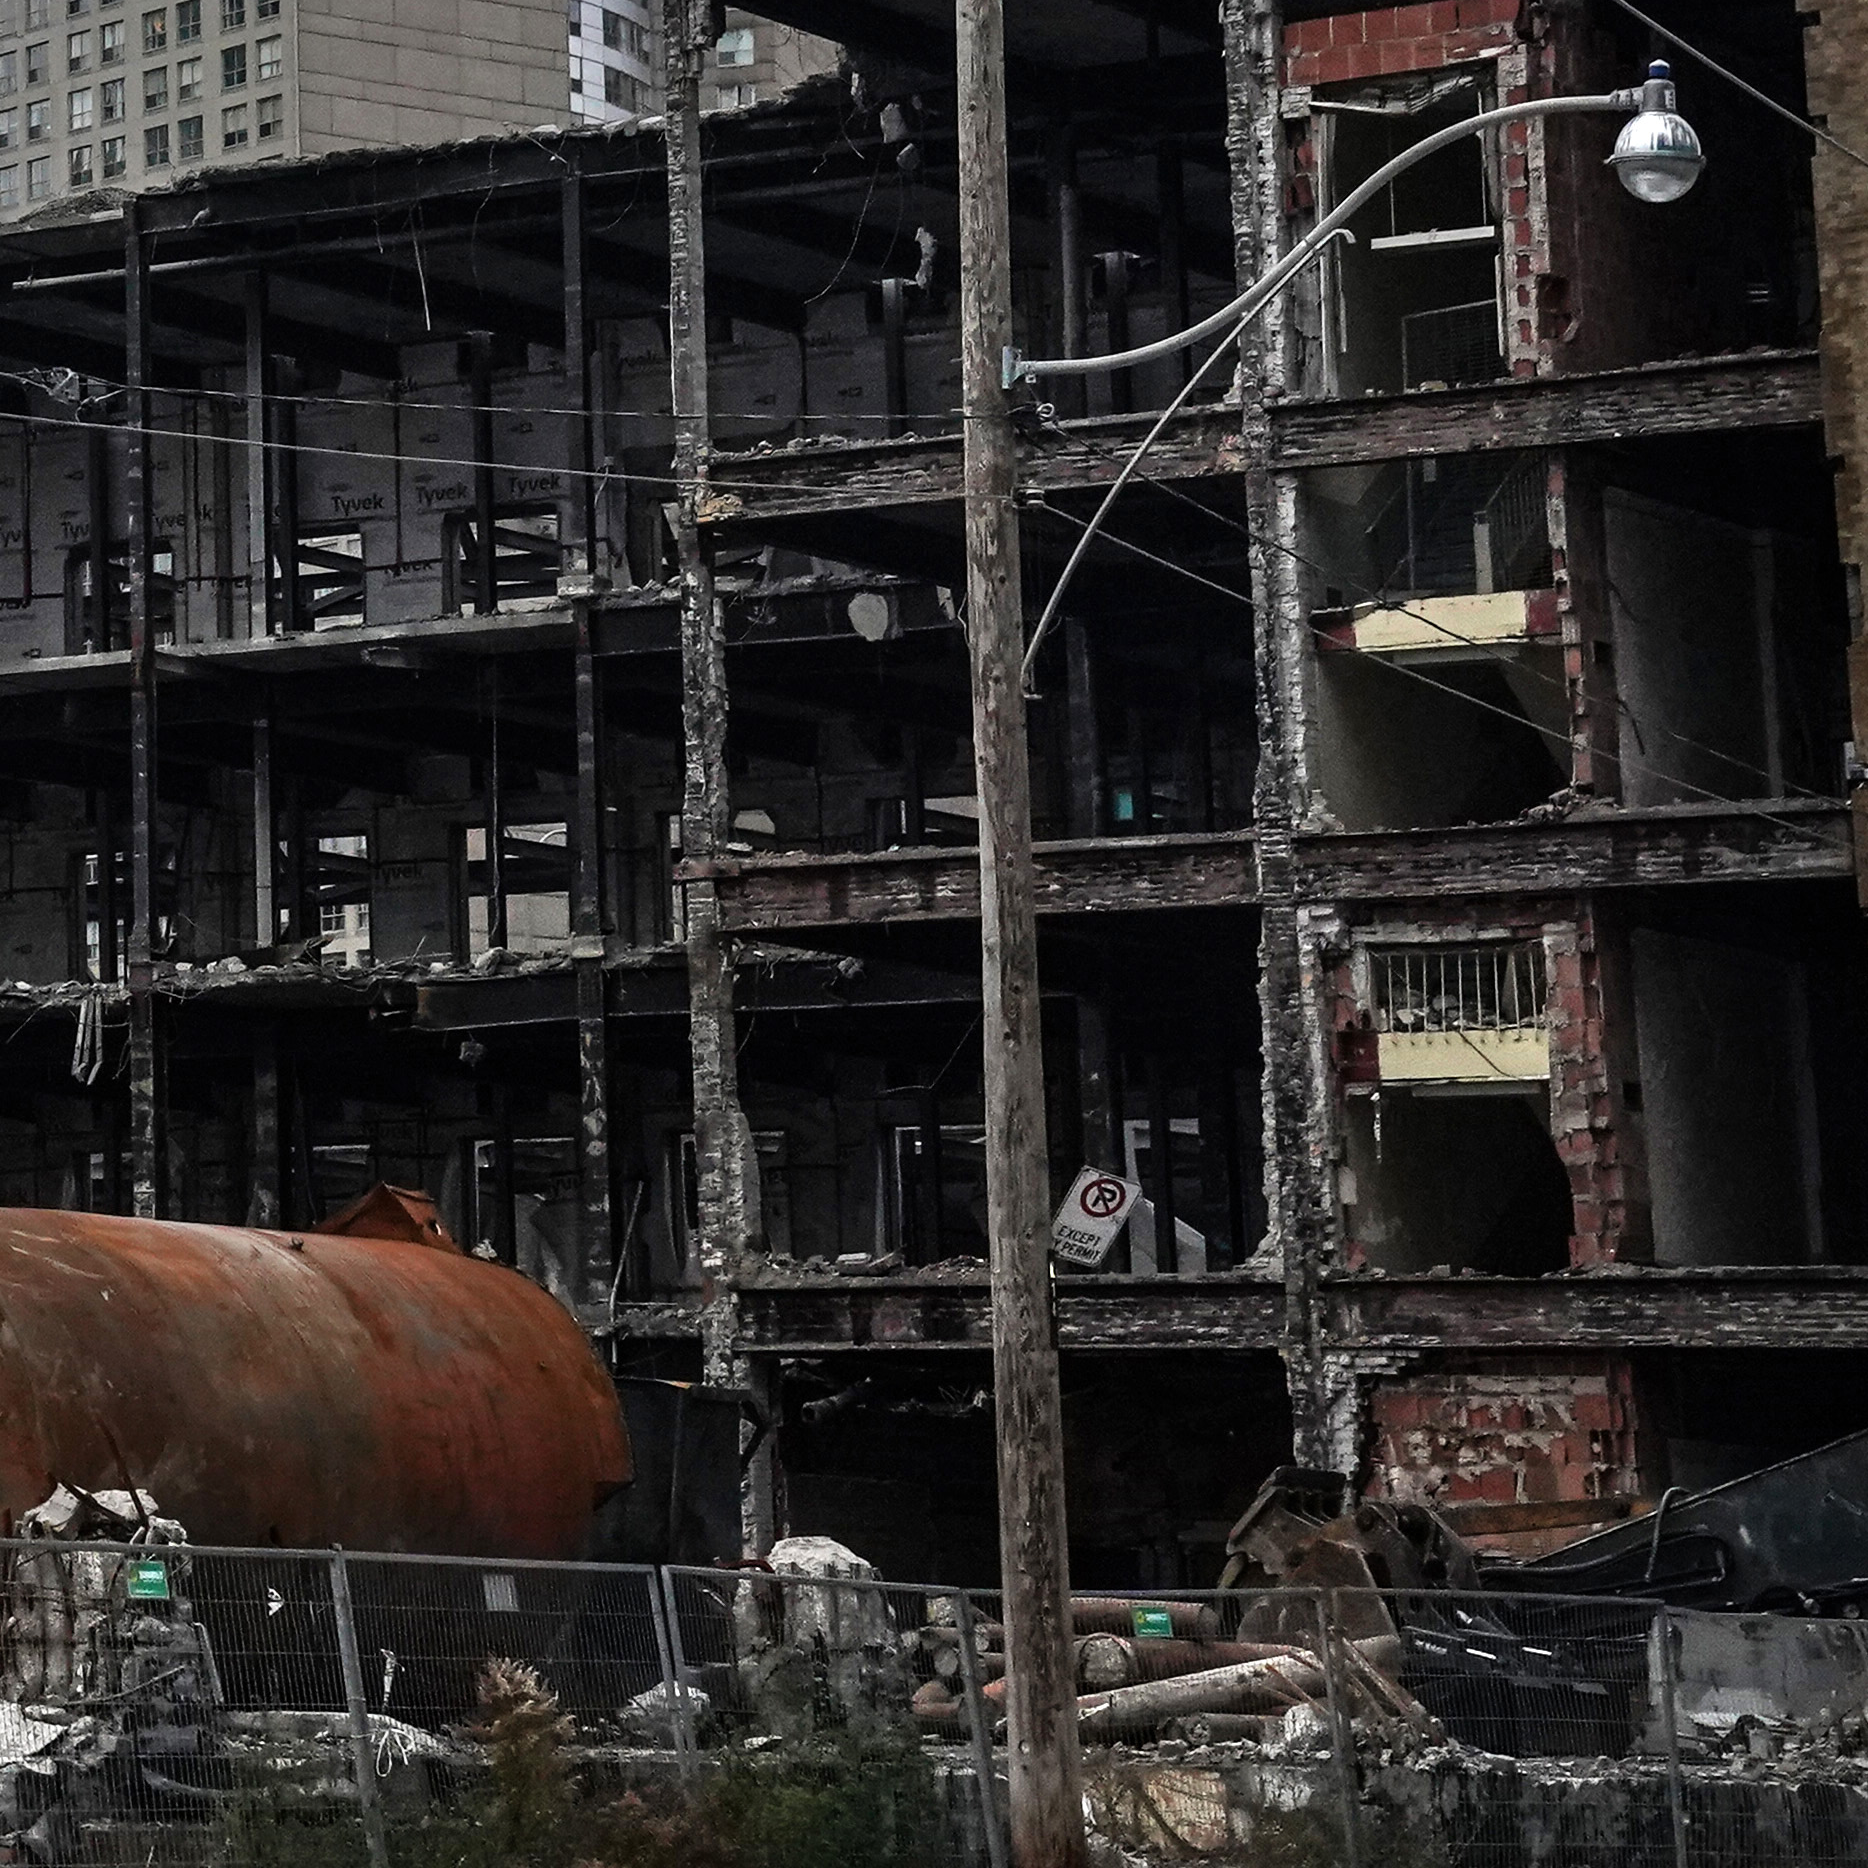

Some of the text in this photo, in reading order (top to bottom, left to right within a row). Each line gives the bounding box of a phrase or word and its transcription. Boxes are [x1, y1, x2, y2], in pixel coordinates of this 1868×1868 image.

[417, 483, 468, 506] Tyvek
[508, 473, 561, 495] Tyvek
[331, 493, 385, 516] Tyvek
[61, 522, 89, 542] Tyv
[1058, 1225, 1101, 1247] EXCEPT
[1061, 1241, 1100, 1260] PERMIT
